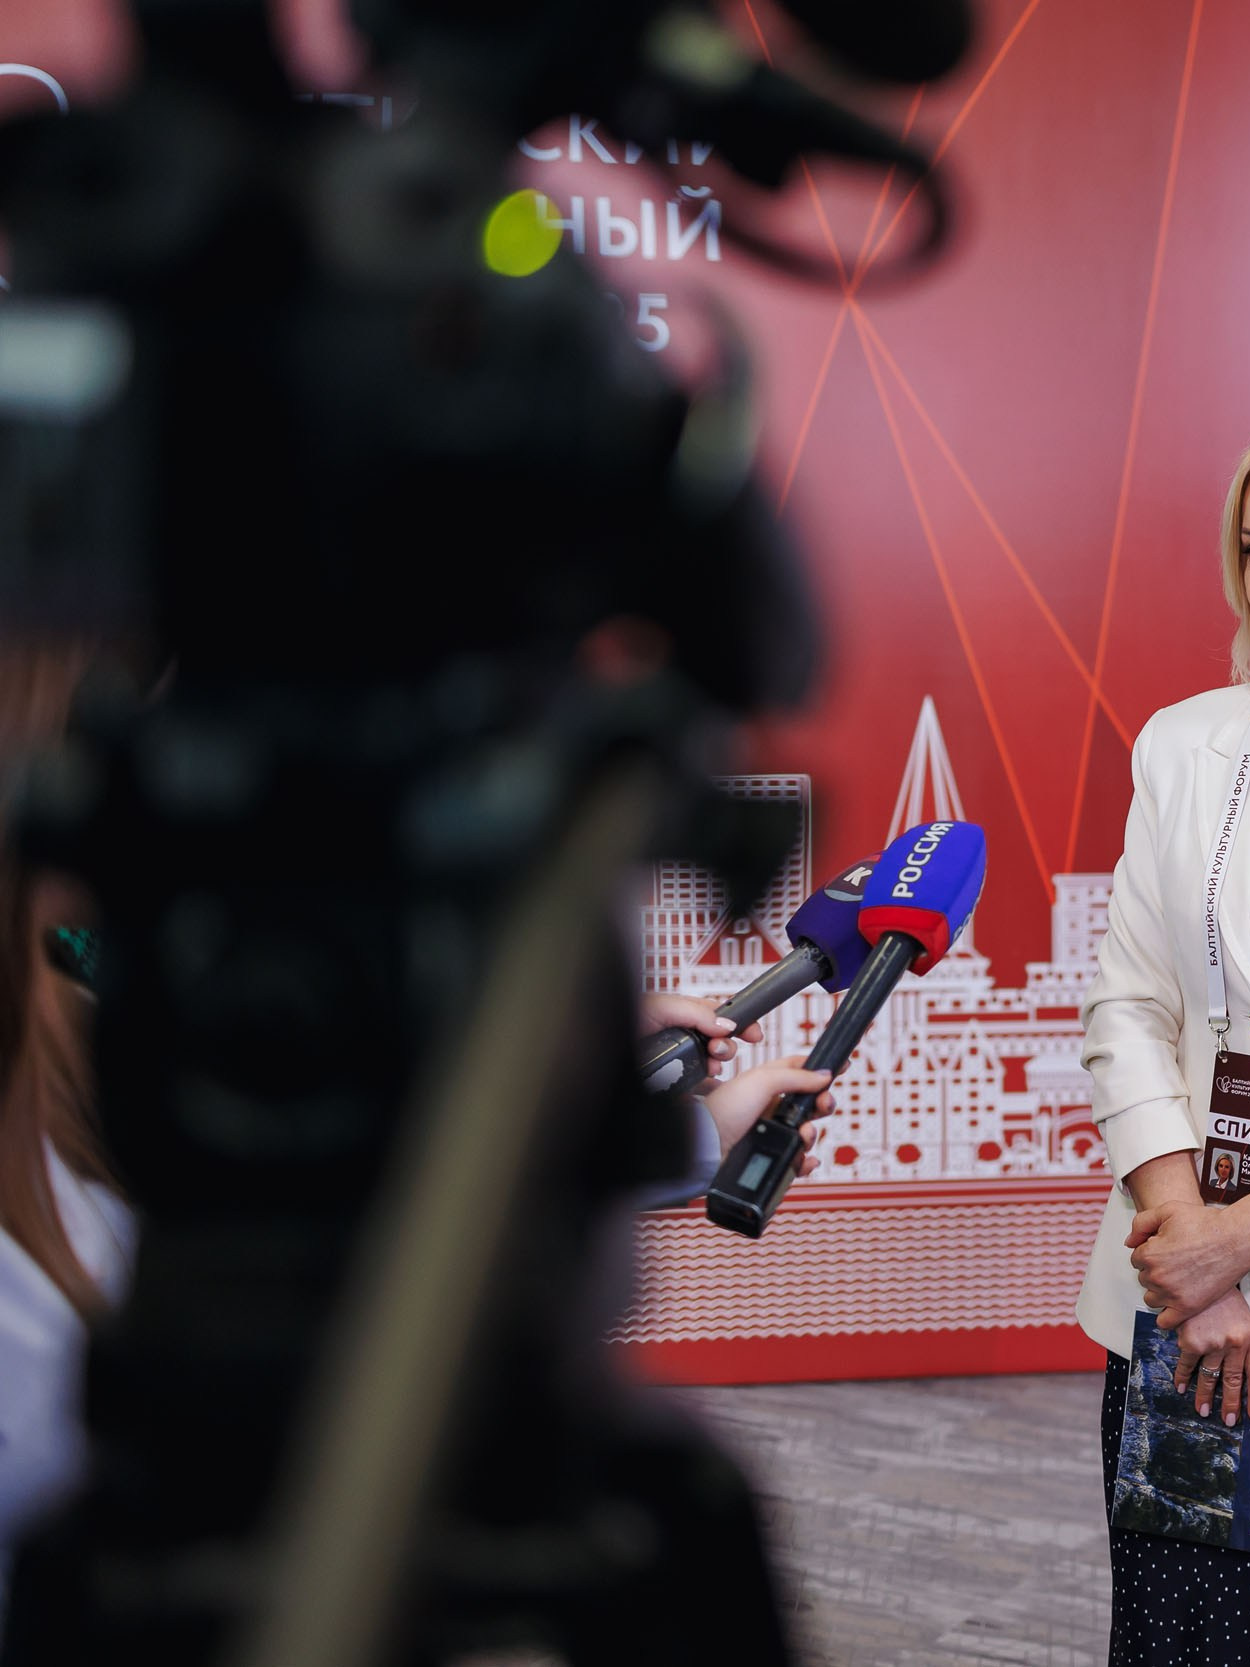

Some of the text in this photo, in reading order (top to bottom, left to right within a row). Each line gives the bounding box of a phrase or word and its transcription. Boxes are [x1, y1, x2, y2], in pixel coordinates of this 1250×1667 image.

[892, 822, 954, 899] РОССИЯ
[1211, 798, 1239, 875] КУЛЬТУРНЫЙ
[1205, 877, 1219, 966] БАЛТИЙСКИЙ
